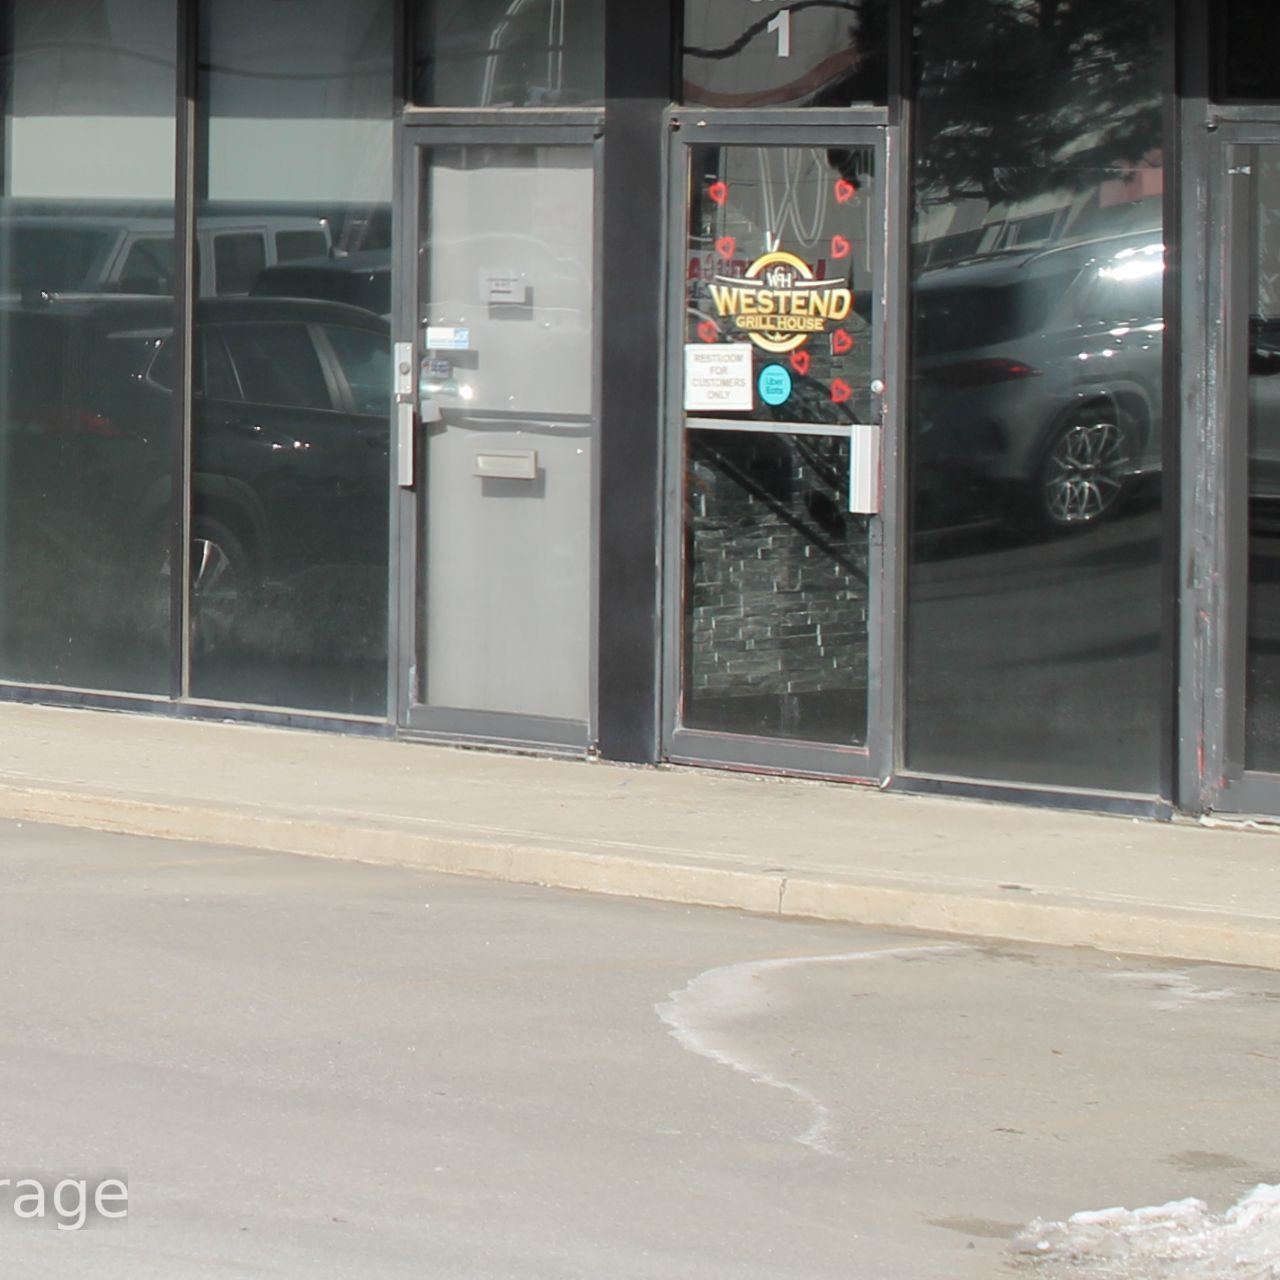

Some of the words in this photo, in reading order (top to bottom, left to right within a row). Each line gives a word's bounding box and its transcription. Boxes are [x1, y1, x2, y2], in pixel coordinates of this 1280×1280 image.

[767, 9, 790, 57] 1
[707, 283, 852, 321] WESTEND
[735, 315, 775, 329] GRILL
[776, 316, 825, 331] HOUSE
[693, 353, 744, 363] RESTROOM
[709, 366, 729, 375] FOR
[691, 378, 746, 388] CUSTOMERS
[706, 390, 732, 400] ONLY
